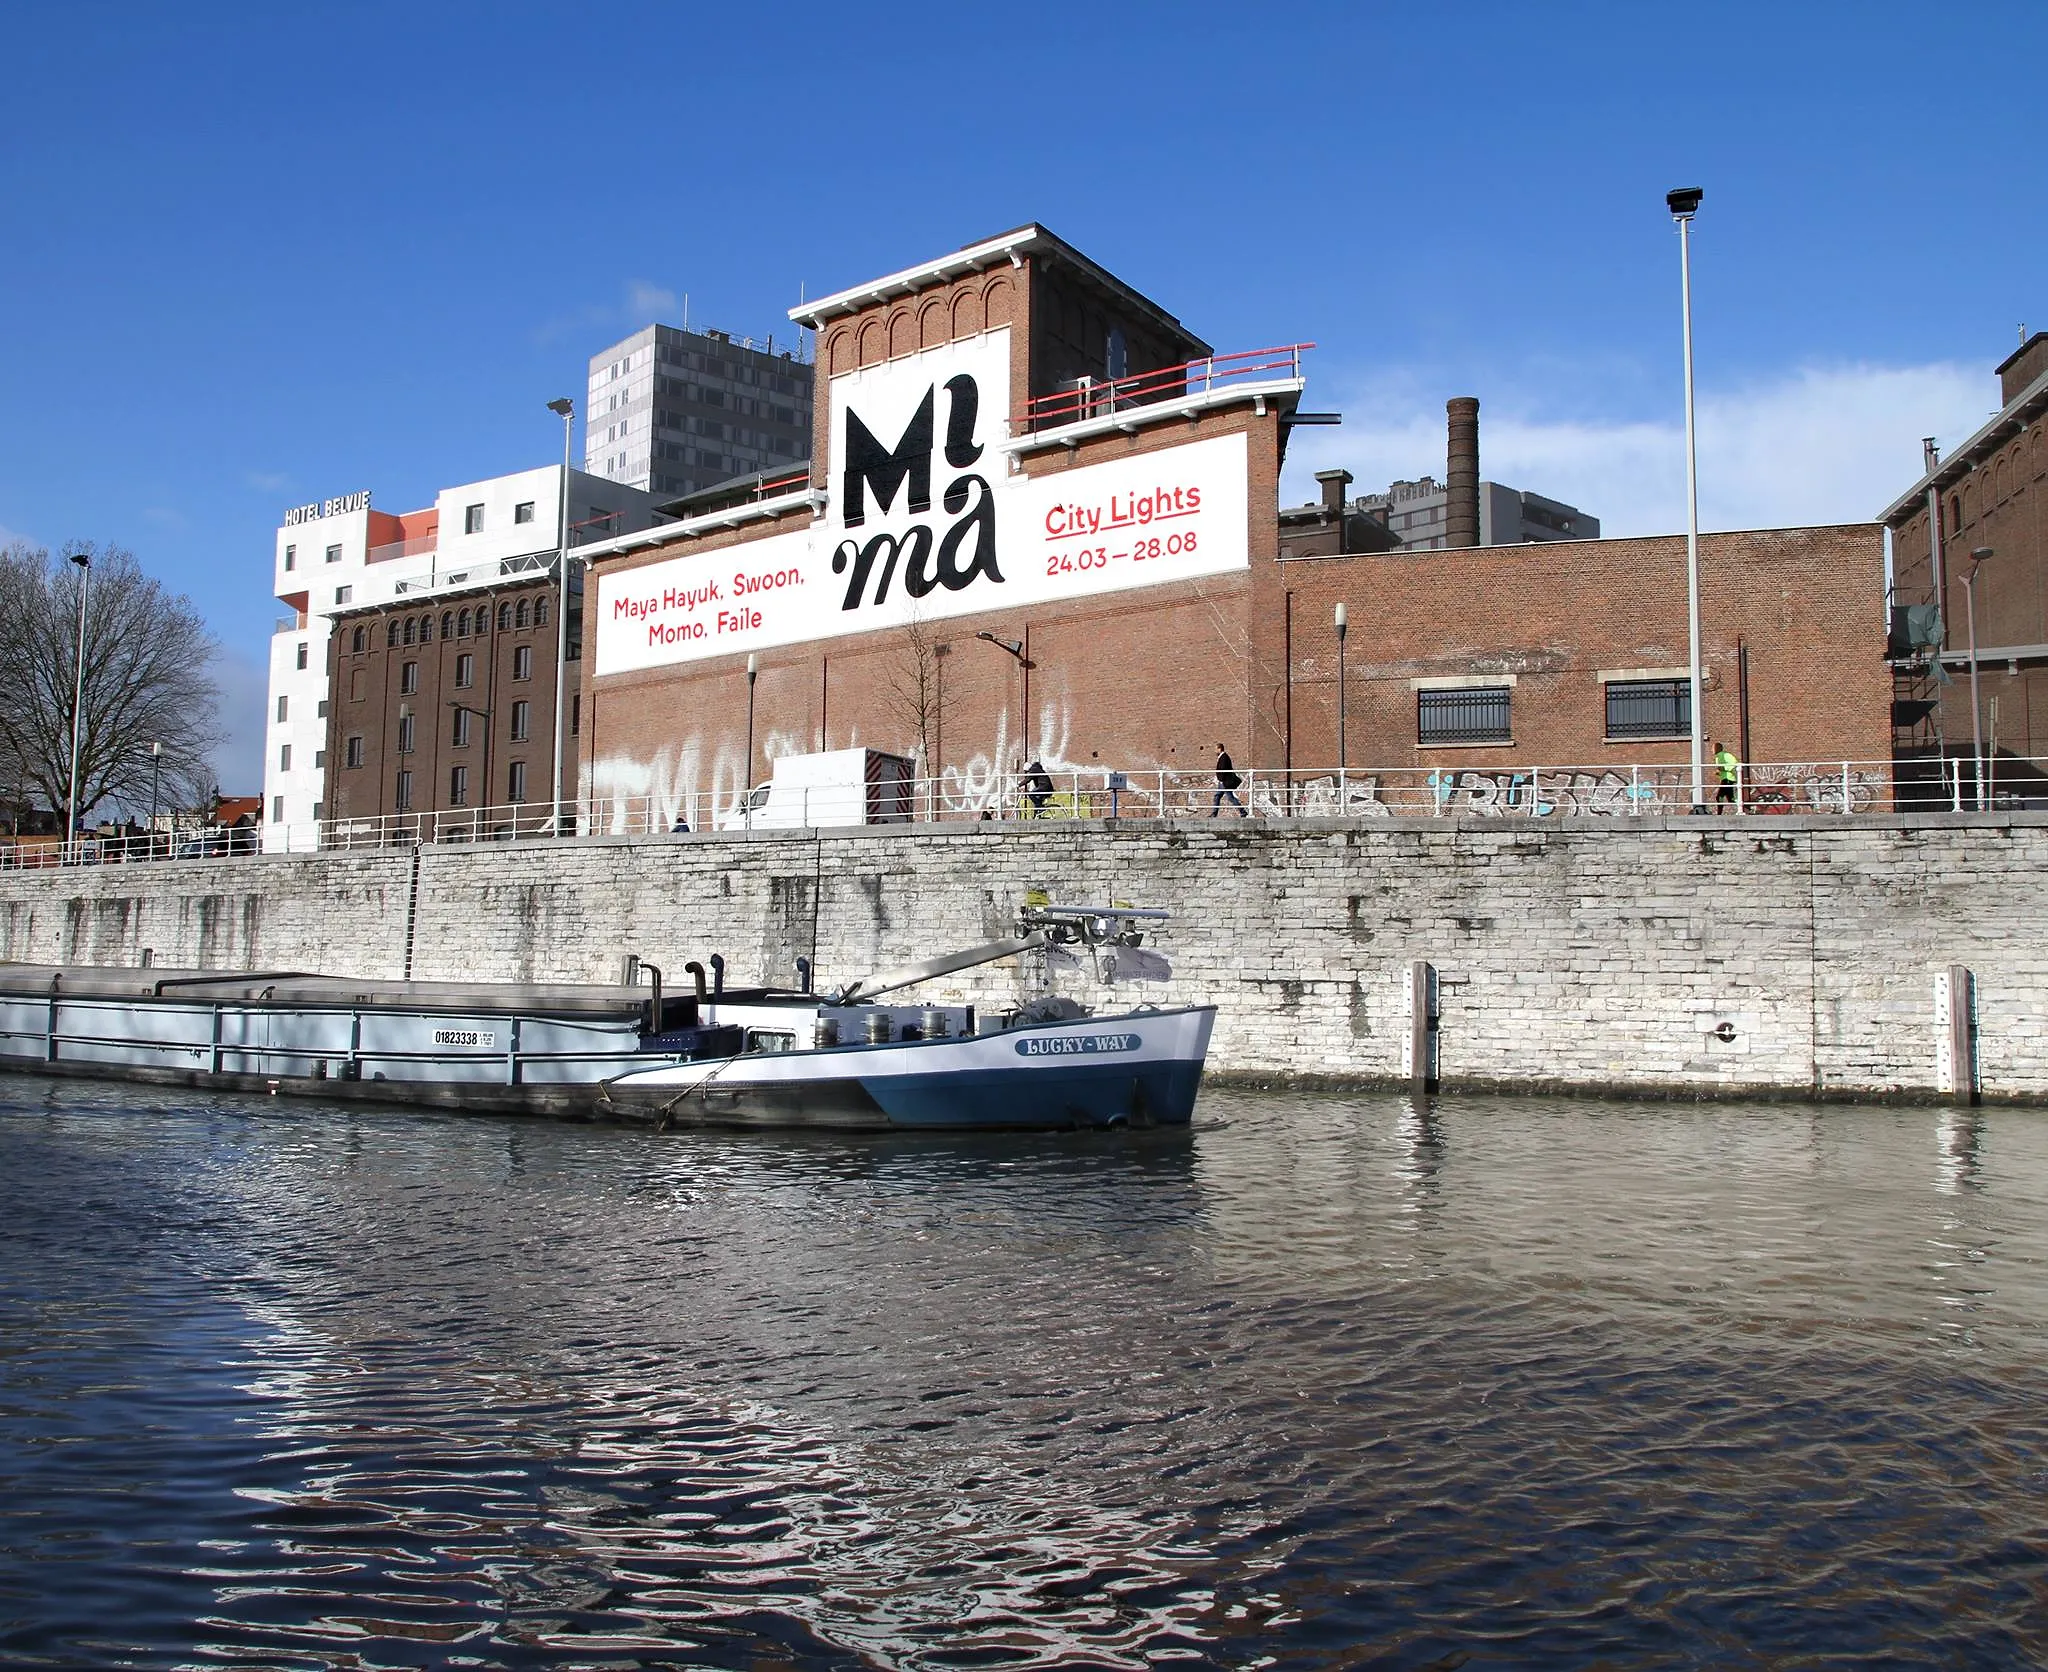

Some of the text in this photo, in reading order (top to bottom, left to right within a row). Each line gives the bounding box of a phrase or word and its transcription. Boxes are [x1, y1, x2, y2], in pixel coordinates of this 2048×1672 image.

[285, 490, 372, 527] HOTEL BELVUE
[1045, 486, 1201, 535] City Lights
[1046, 548, 1108, 577] 24.03
[1133, 531, 1198, 562] 28.08
[613, 568, 805, 621] Maya Hayuk, Swoon,
[649, 607, 763, 646] Momo, Faile
[435, 1030, 478, 1045] 01823338
